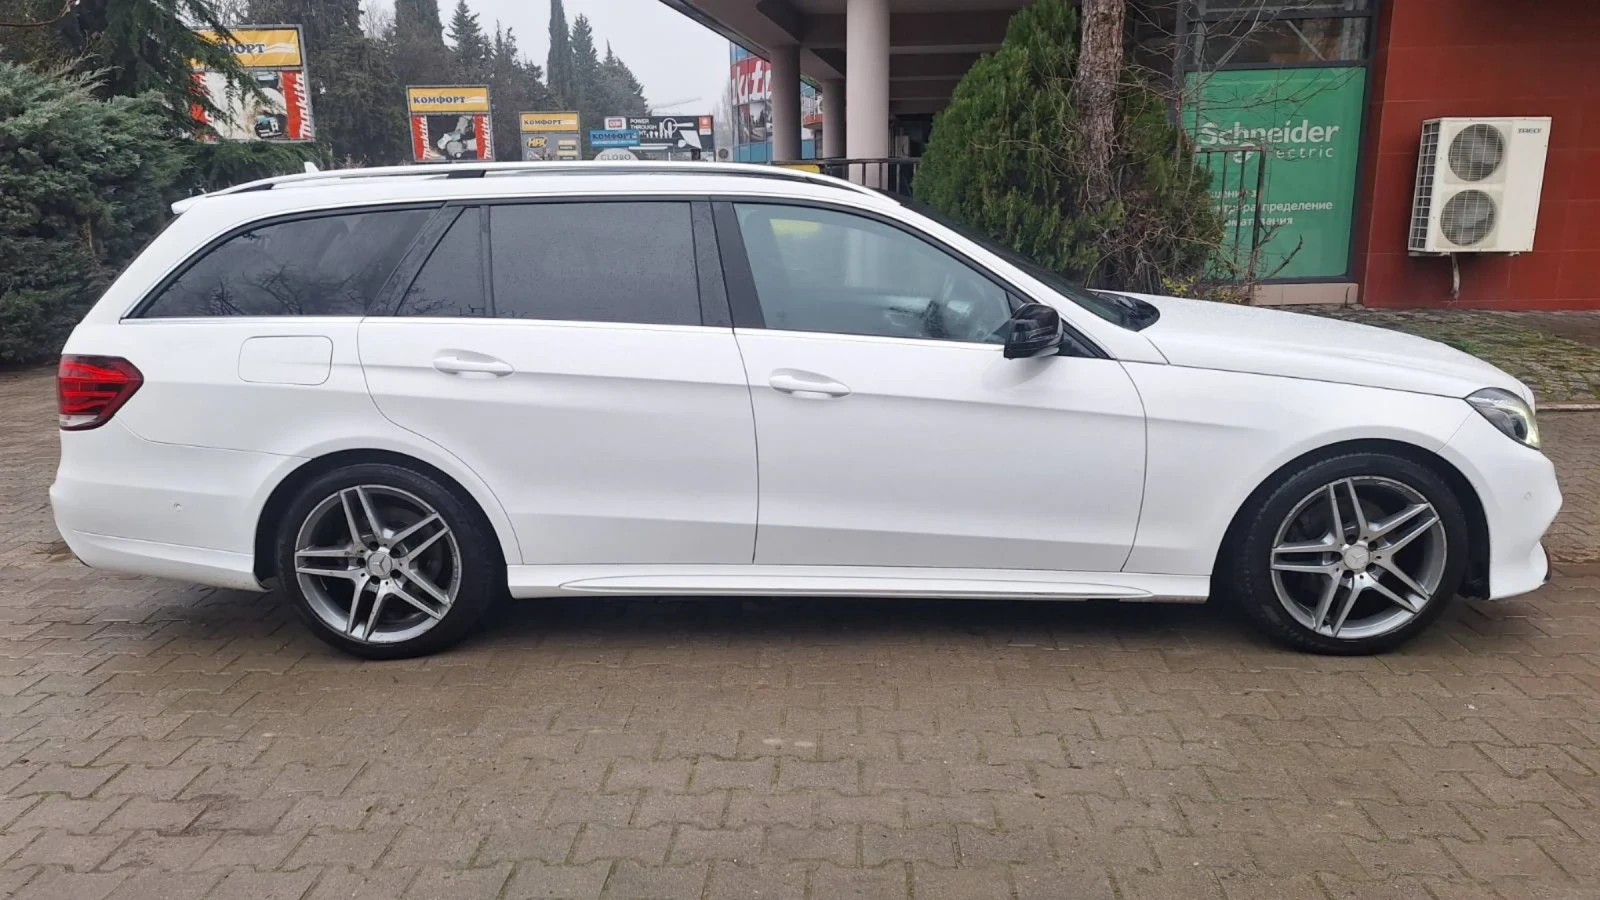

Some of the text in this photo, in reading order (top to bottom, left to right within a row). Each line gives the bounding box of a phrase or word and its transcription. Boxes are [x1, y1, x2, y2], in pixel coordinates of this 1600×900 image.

[219, 43, 266, 54] ФОРТ
[413, 96, 466, 105] КОМФОРТ
[1200, 119, 1340, 145] Schneider
[1276, 145, 1334, 159] ectric
